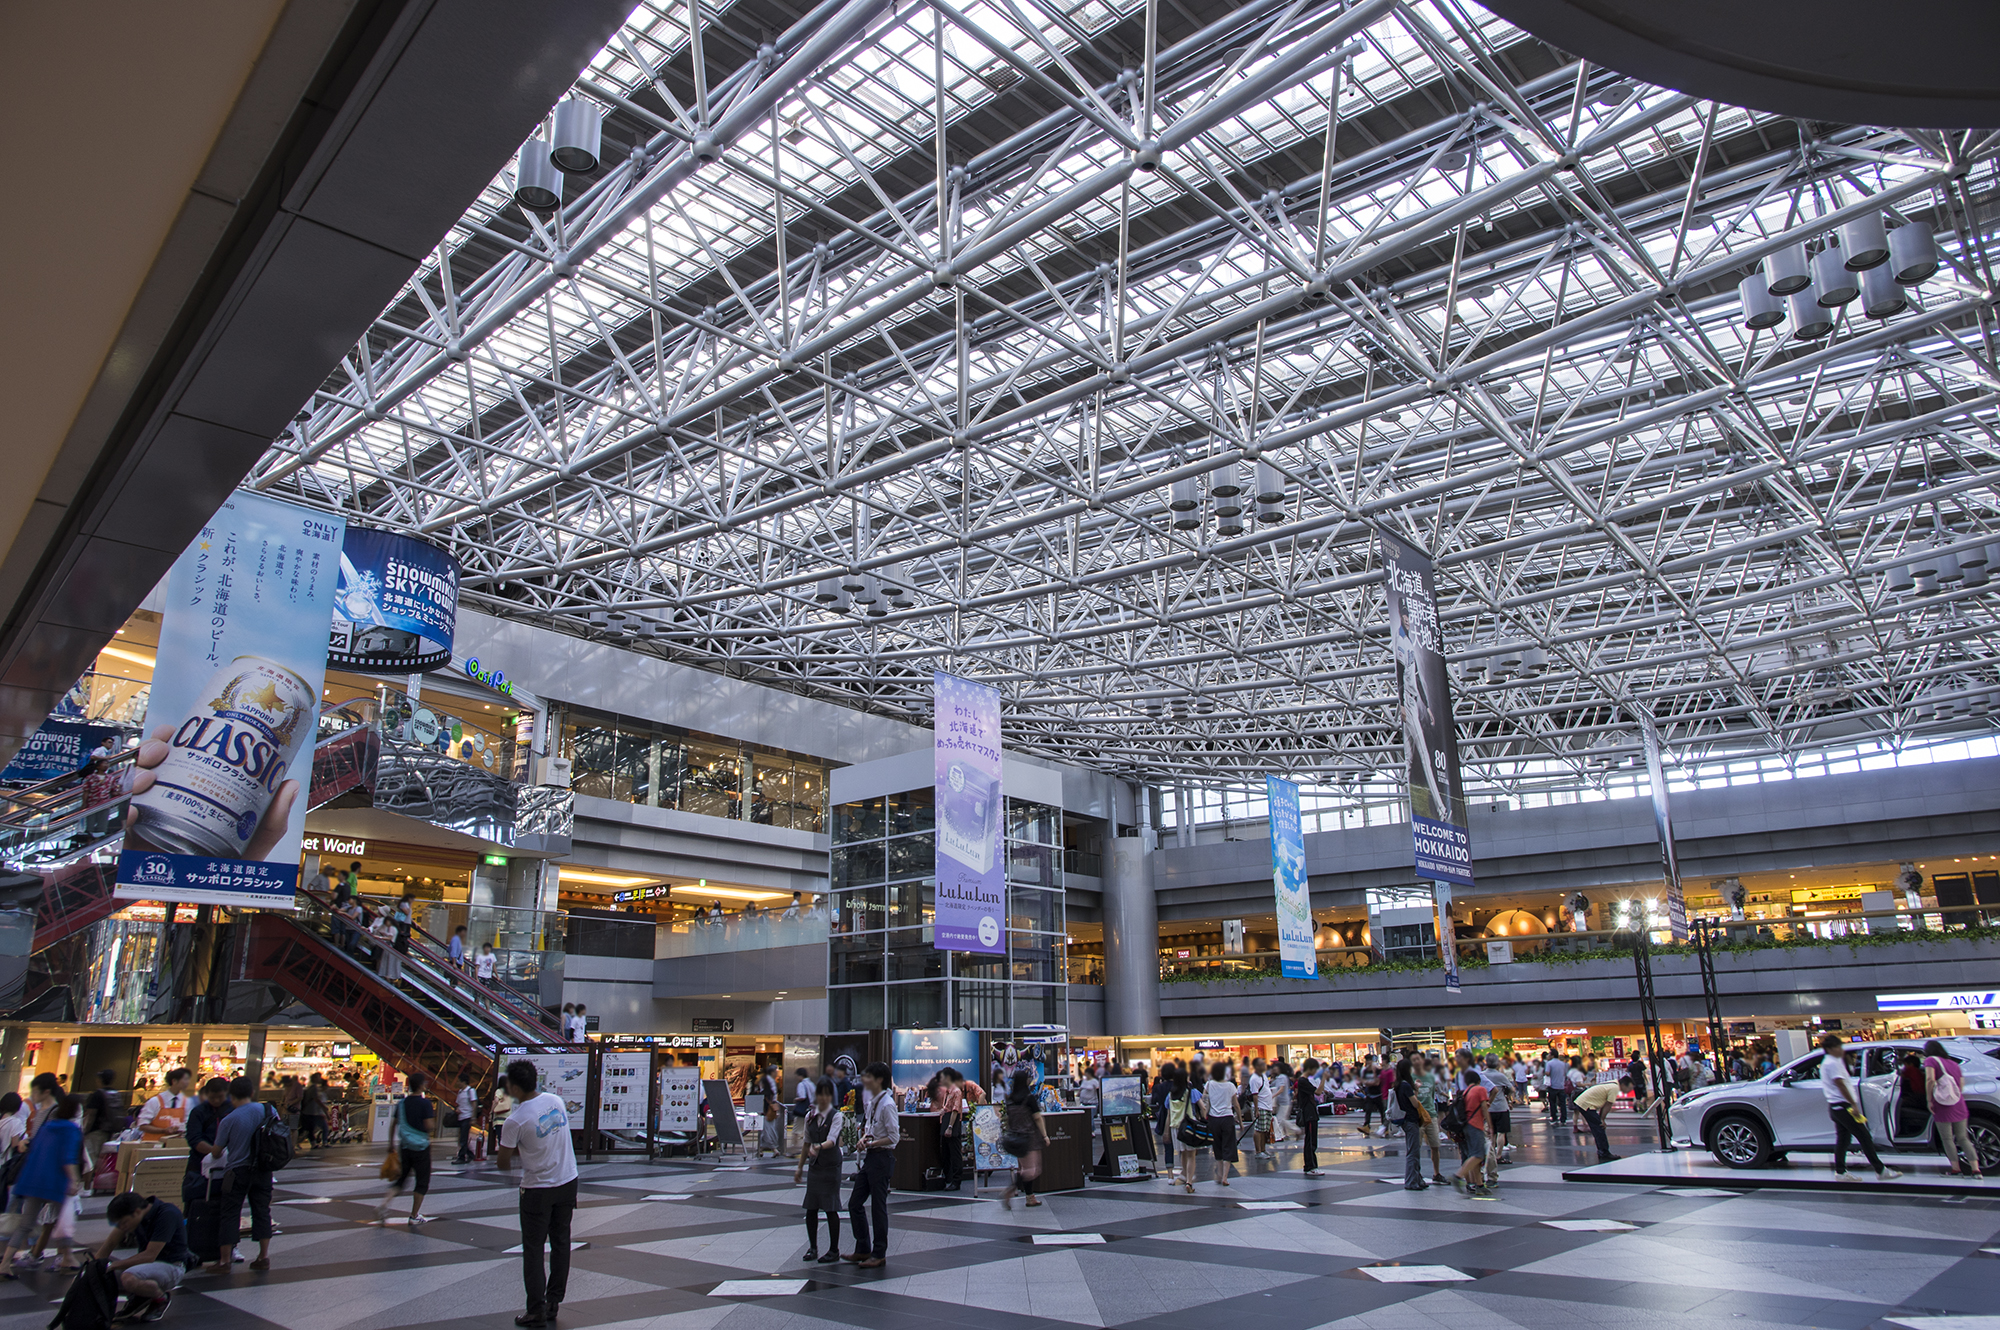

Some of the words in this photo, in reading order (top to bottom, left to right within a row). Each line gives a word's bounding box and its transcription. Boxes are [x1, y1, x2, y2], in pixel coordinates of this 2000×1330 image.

[201, 526, 215, 540] 新
[302, 528, 331, 541] 北海道
[303, 520, 339, 540] ONLY
[254, 540, 268, 604] さらなるおいしさ。
[274, 544, 287, 580] 北海道の、
[190, 553, 209, 606] クラシック
[289, 548, 304, 603] 爽やかな味わい。
[307, 552, 321, 602] 素材のうまみ、
[385, 575, 419, 595] SKY
[205, 532, 237, 668] これが、北海道のビール。
[465, 656, 493, 685] Oasis
[491, 670, 514, 695] Park
[226, 711, 243, 719] ONLY
[244, 715, 275, 738] HOKKAIDO
[239, 703, 275, 725] SAPPORO
[949, 721, 987, 739] 北海道で
[173, 716, 286, 796] CLASSIC
[1434, 749, 1447, 770] 80
[187, 751, 259, 790] サッポロクラシック
[1412, 821, 1454, 842] WELCOME
[1455, 832, 1467, 844] TO
[323, 837, 366, 855] World
[1414, 836, 1469, 862] HOKKAIDO
[186, 873, 284, 889] サッポロクラシック
[206, 862, 269, 877] 北海道限定
[939, 881, 1000, 904] LuLuLun
[1282, 928, 1314, 944] LuLuLun
[1949, 995, 1981, 1006] ANA
